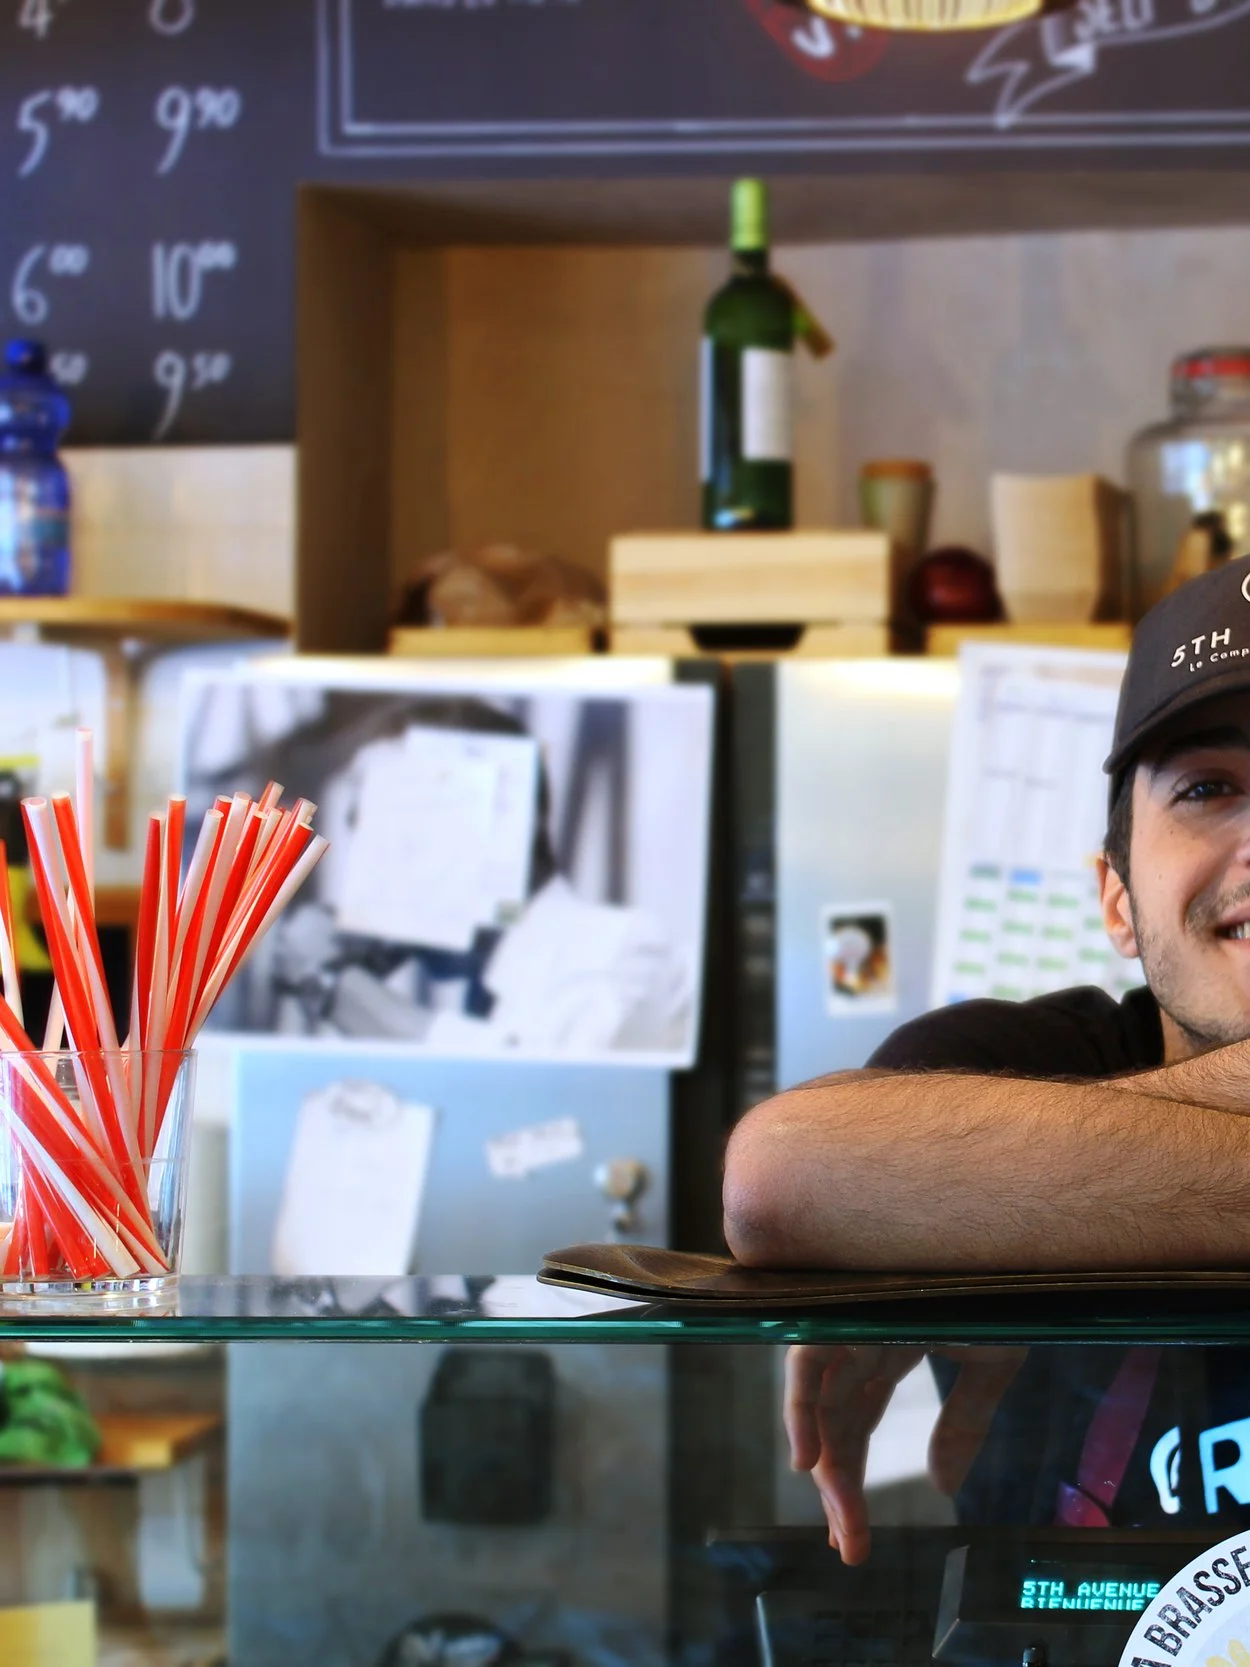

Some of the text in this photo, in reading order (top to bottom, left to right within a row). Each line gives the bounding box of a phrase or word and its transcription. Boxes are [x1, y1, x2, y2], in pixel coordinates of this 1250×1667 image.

[1171, 627, 1231, 668] 5TH
[1189, 661, 1203, 672] Le
[1022, 1580, 1161, 1598] 5TH AVENUE
